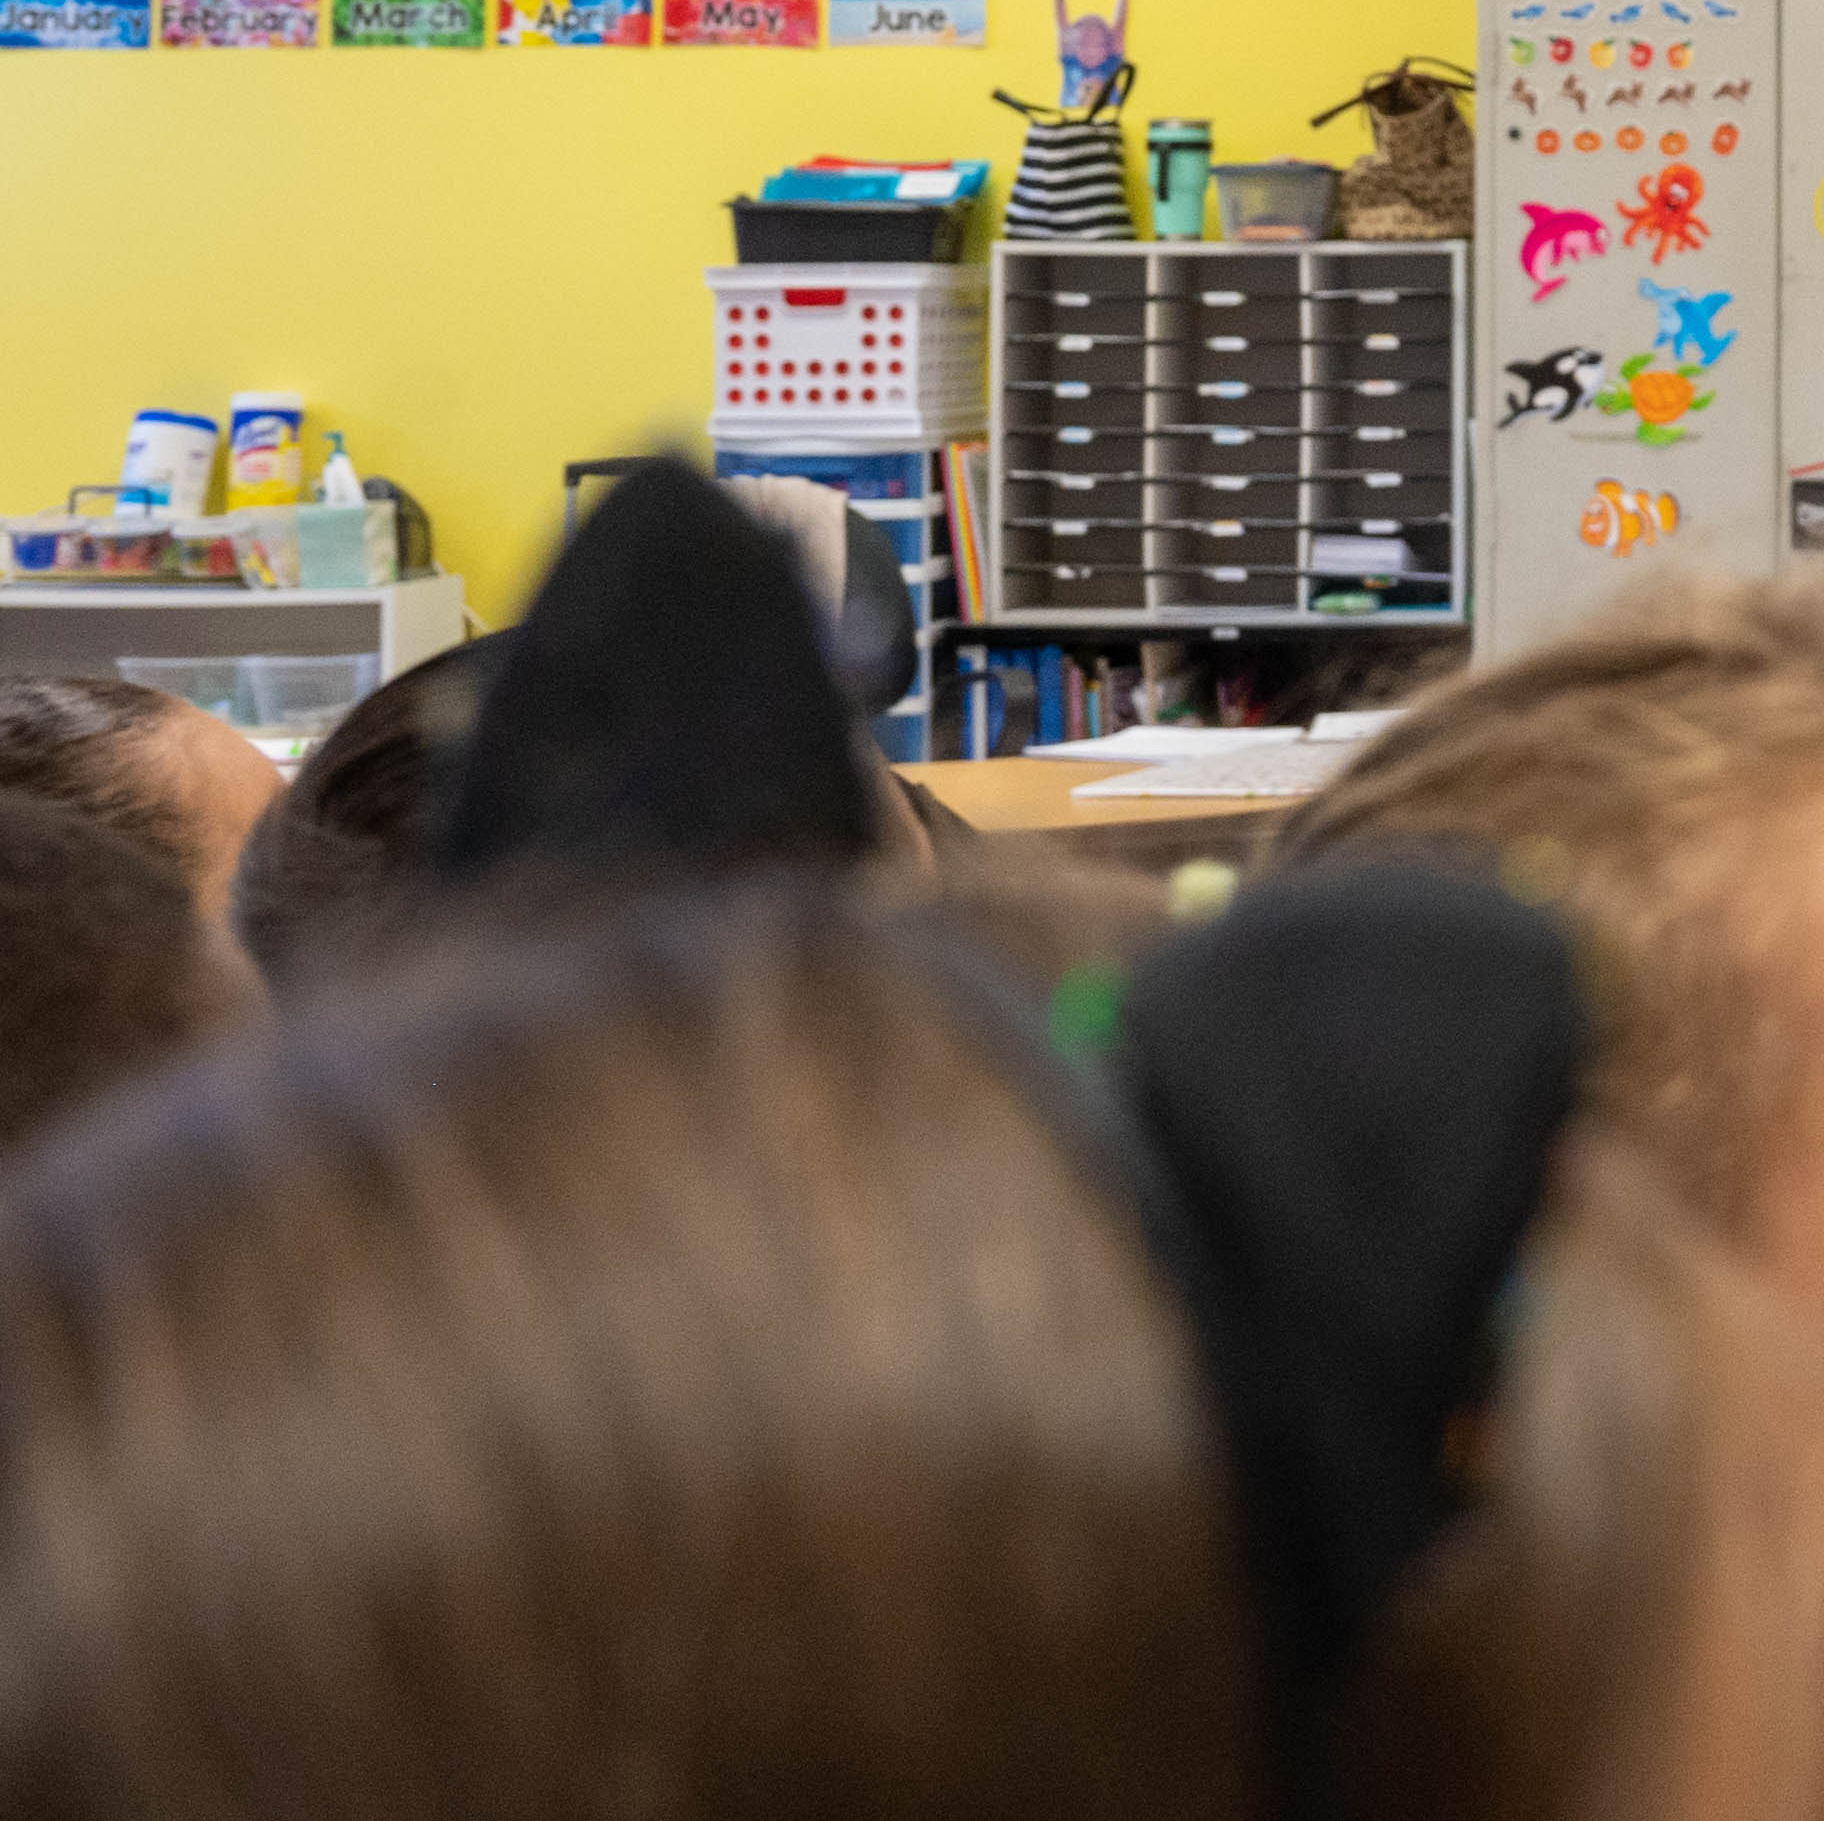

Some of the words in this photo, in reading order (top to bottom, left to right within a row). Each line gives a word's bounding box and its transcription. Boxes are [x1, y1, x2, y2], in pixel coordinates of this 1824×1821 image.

[1, 4, 143, 38] January
[703, 0, 781, 33] May
[869, 2, 948, 32] June
